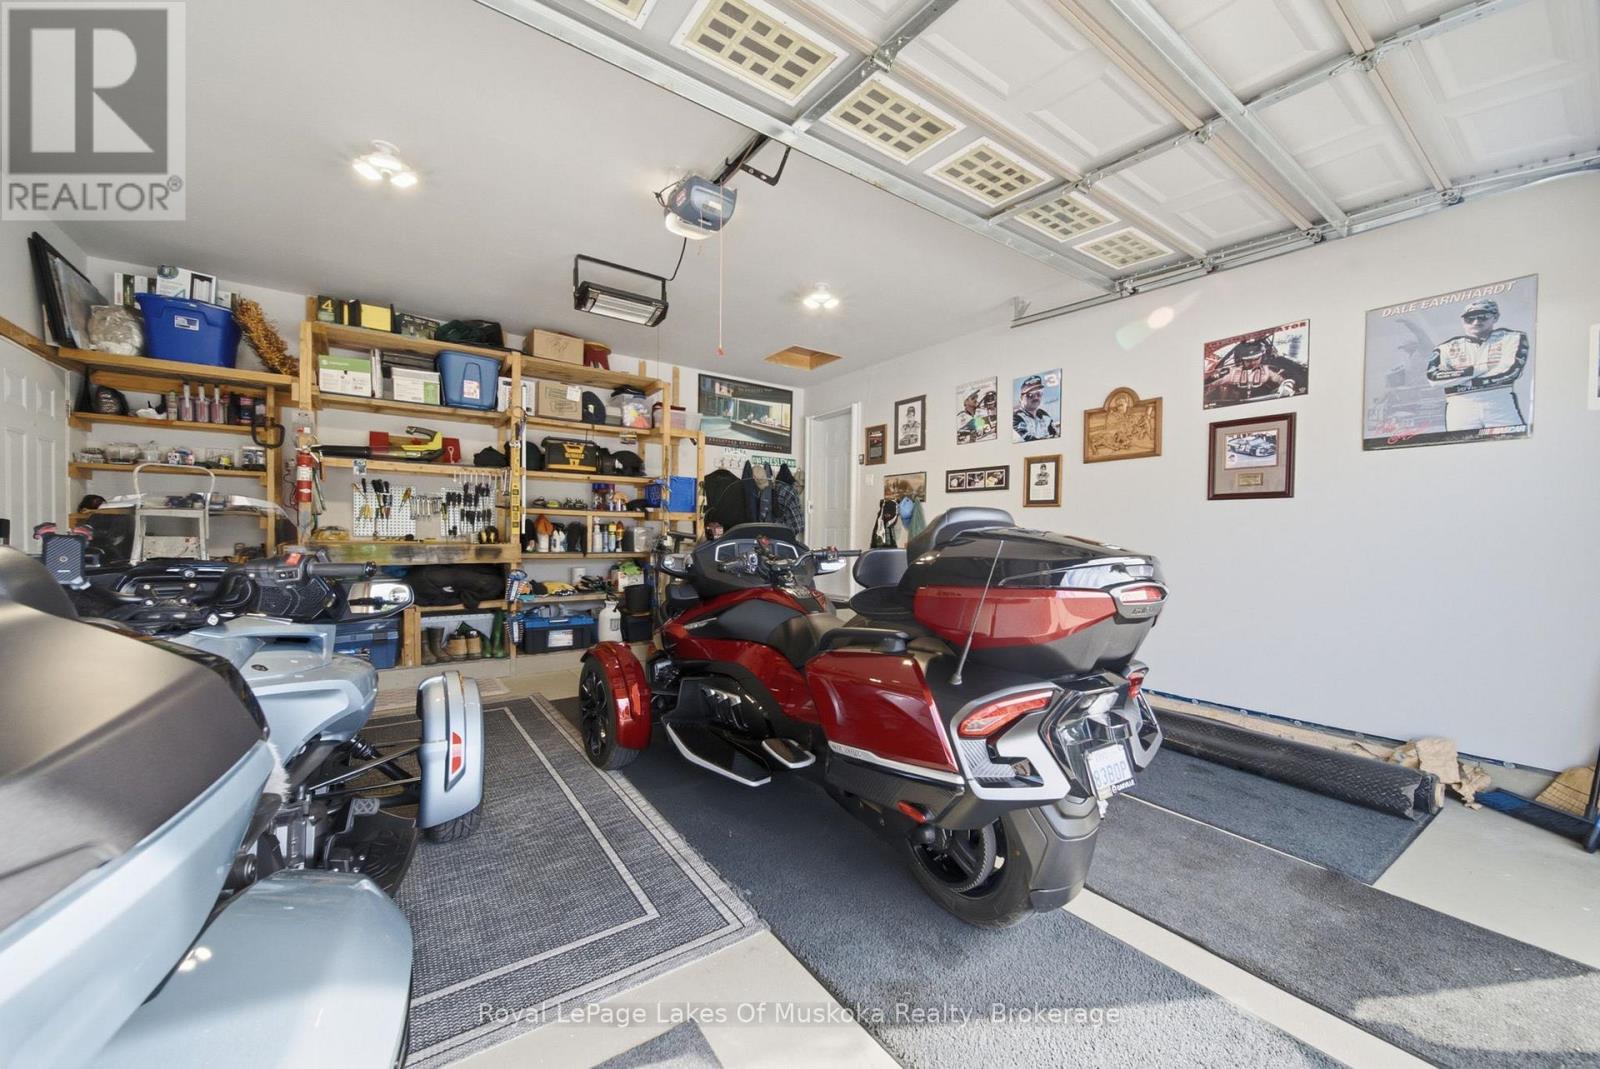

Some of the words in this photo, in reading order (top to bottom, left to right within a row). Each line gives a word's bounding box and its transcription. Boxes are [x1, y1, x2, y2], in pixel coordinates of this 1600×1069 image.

[1381, 302, 1417, 317] DALE
[1420, 280, 1517, 310] EARNHARDT
[322, 300, 334, 312] 4
[1044, 374, 1057, 387] 3
